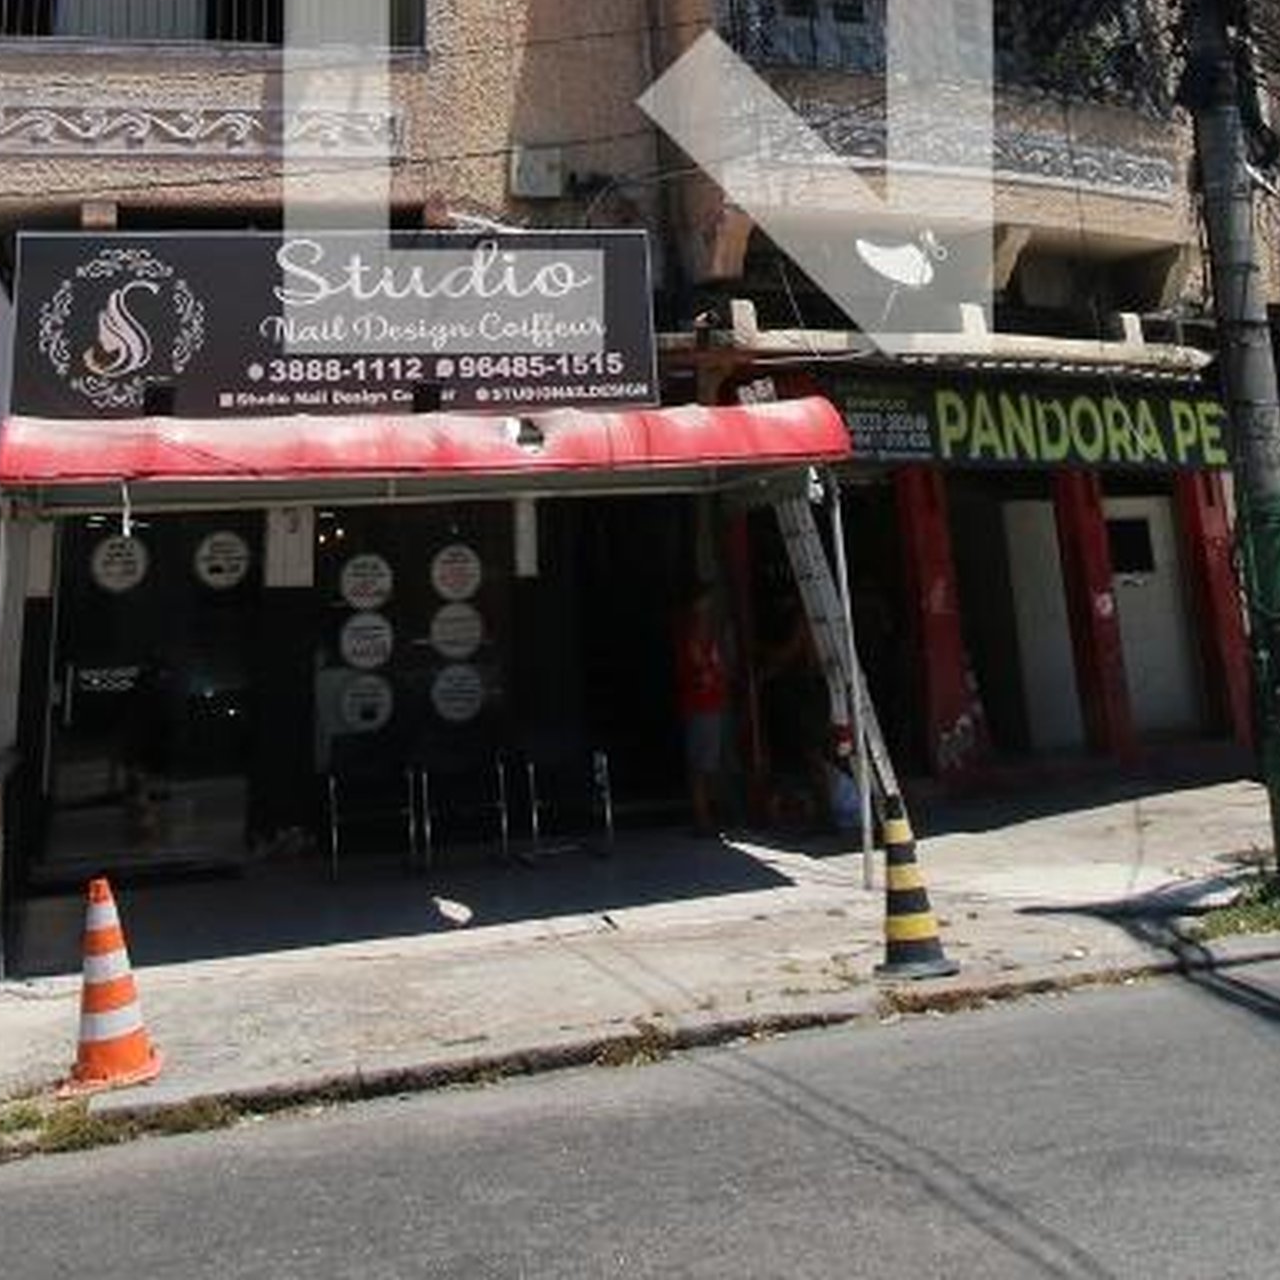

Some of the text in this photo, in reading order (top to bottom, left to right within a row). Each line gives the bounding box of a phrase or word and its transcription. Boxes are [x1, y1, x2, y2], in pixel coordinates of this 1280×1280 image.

[273, 239, 592, 305] Studio
[259, 315, 348, 344] Nail
[352, 317, 474, 351] Design
[270, 352, 624, 382] 3888-1112 96485-1515
[935, 388, 1168, 463] PANDORA
[1170, 399, 1228, 464] PE
